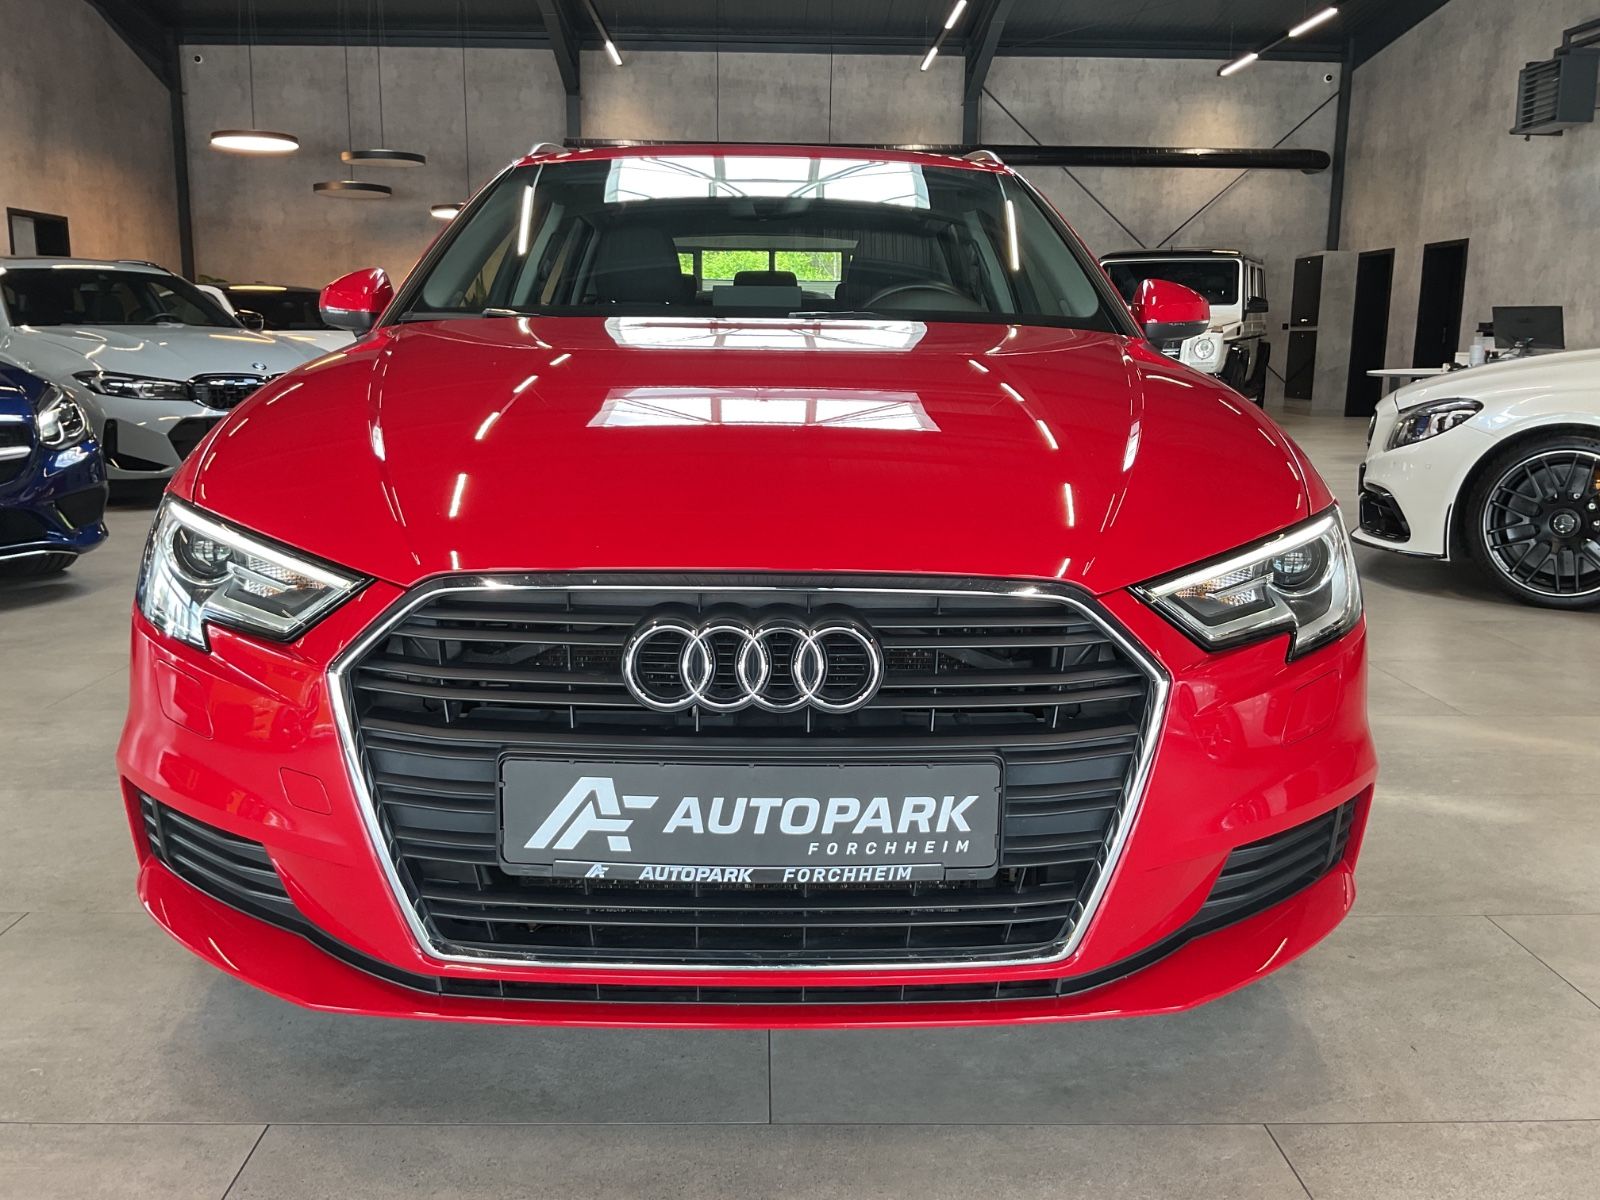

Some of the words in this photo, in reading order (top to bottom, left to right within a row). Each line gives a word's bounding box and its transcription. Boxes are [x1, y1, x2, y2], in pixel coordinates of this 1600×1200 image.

[662, 795, 979, 835] AUTOPARK
[807, 839, 970, 856] FORCHHEIM
[639, 866, 753, 883] AUTOPARK
[783, 865, 913, 883] FORCHHEIM
